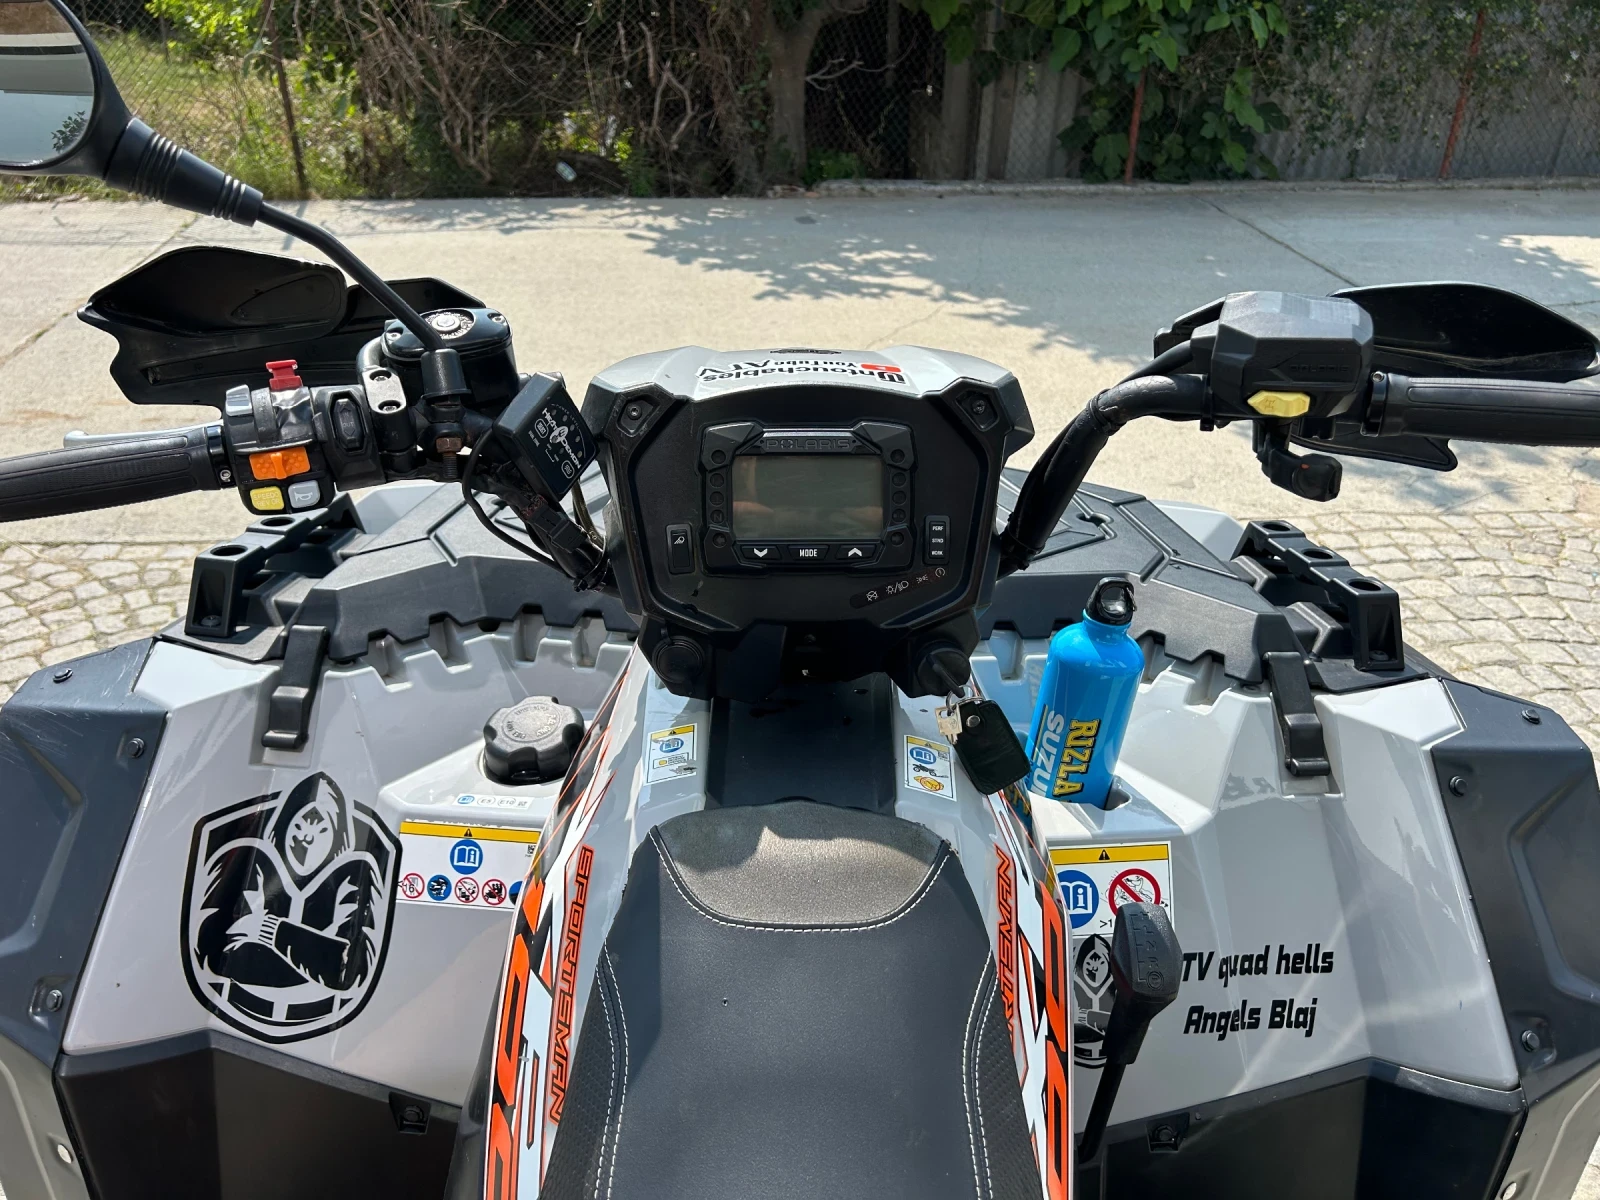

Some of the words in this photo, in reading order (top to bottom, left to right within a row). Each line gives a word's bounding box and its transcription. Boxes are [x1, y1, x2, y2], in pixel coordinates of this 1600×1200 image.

[561, 437, 582, 469] DEMON
[766, 440, 850, 449] POLARIS
[799, 549, 818, 557] MODE
[1218, 945, 1271, 988] quad
[1275, 943, 1334, 975] hells
[549, 845, 594, 1124] SPORTSMAN
[1183, 999, 1262, 1041] Angels
[1268, 998, 1318, 1037] Blaj
